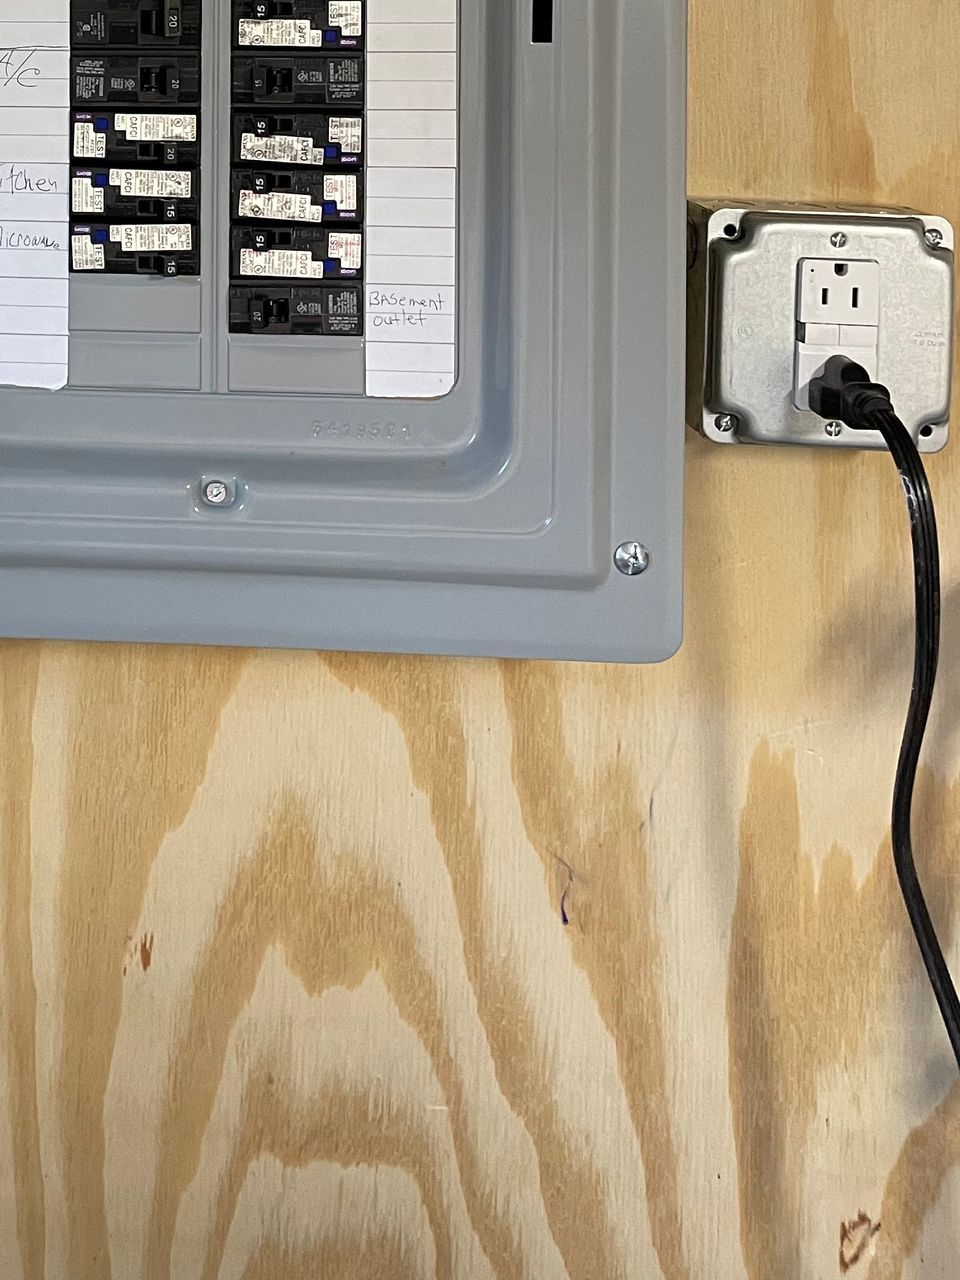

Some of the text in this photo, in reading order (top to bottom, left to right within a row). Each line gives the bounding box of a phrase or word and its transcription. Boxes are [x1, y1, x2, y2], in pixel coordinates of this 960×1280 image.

[169, 15, 177, 28] 20
[256, 4, 265, 18] 15
[298, 22, 307, 44] CAFCI
[171, 79, 180, 89] 20
[129, 116, 138, 138] CAFCI
[257, 121, 266, 133] 15
[331, 119, 339, 141] TEST
[96, 135, 104, 156] TEST
[167, 148, 174, 160] 20
[300, 139, 309, 161] CAFCI
[124, 171, 132, 193] CAFCI
[255, 178, 264, 190] 15
[325, 177, 333, 199] TEST
[95, 189, 103, 211] TEST
[298, 197, 307, 219] CAFCI
[167, 205, 175, 217] 15
[124, 227, 132, 249] CAFCI
[255, 235, 264, 248] 15
[95, 246, 103, 267] TEST
[167, 261, 175, 274] 15
[254, 311, 262, 321] 20
